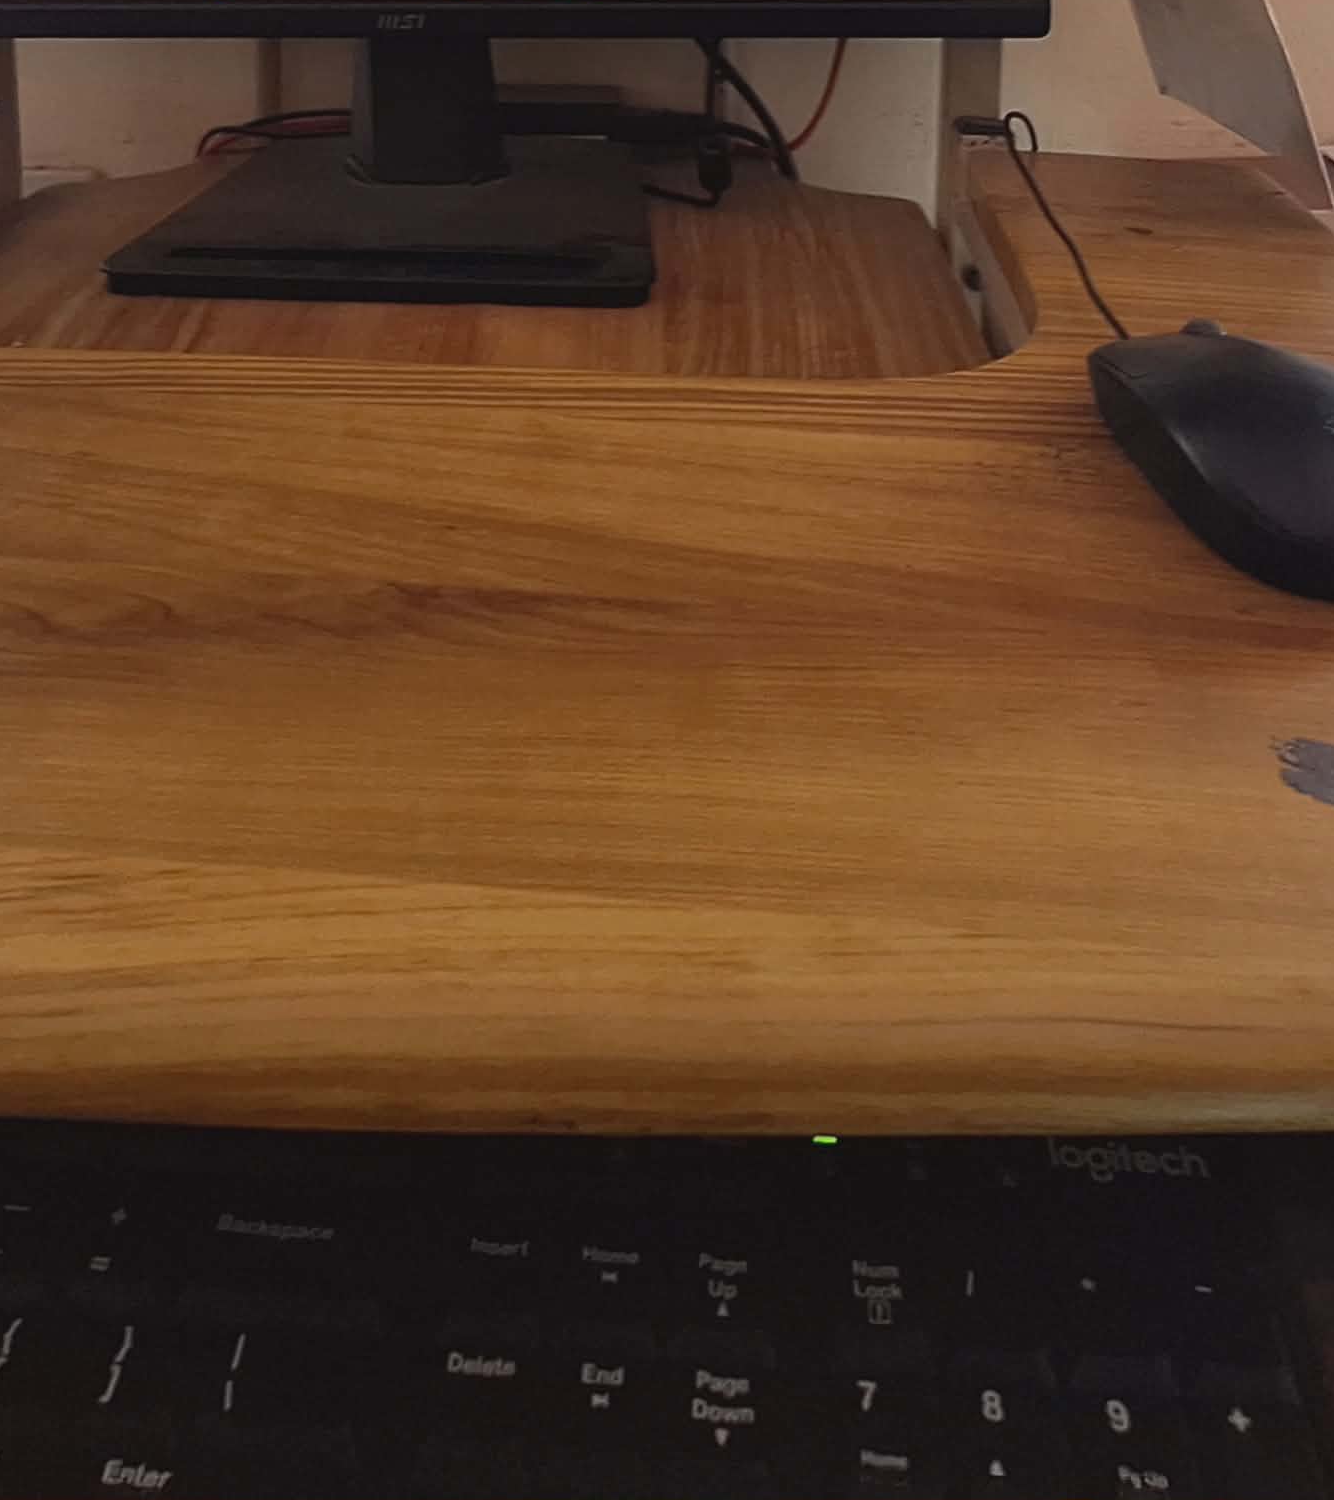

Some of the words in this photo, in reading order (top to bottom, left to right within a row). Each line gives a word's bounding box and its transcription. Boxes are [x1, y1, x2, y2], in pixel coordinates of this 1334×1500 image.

[1046, 1137, 1209, 1181] logitech
[447, 1353, 516, 1377] Delete
[581, 1362, 624, 1386] End
[696, 1369, 749, 1396] Page
[856, 1380, 877, 1411] 7
[691, 1398, 755, 1425] Down
[982, 1390, 1003, 1422] 8
[1107, 1400, 1131, 1432] 9
[101, 1459, 172, 1490] Enter
